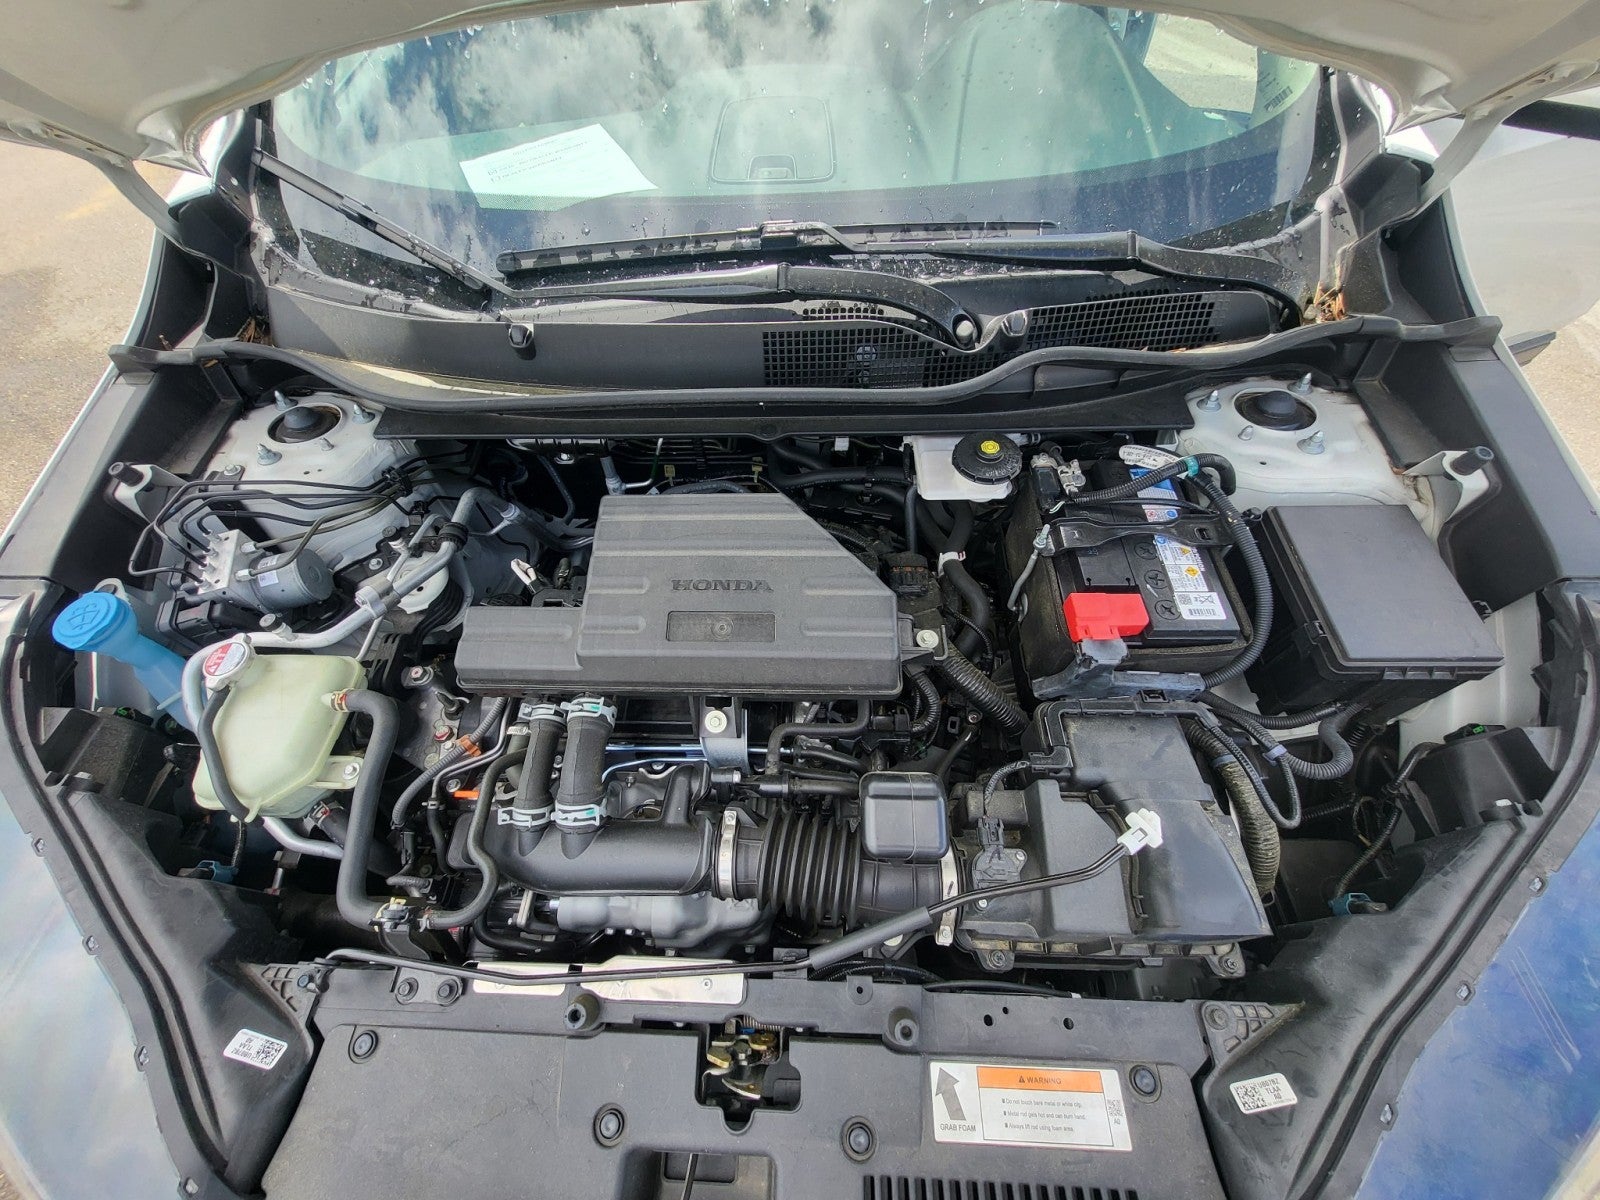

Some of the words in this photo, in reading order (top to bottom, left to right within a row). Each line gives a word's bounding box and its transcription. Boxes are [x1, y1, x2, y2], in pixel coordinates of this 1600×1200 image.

[671, 579, 774, 592] HONDA
[1027, 1076, 1062, 1085] WARNING
[940, 1123, 957, 1131] GRAB
[959, 1124, 976, 1132] FOAM
